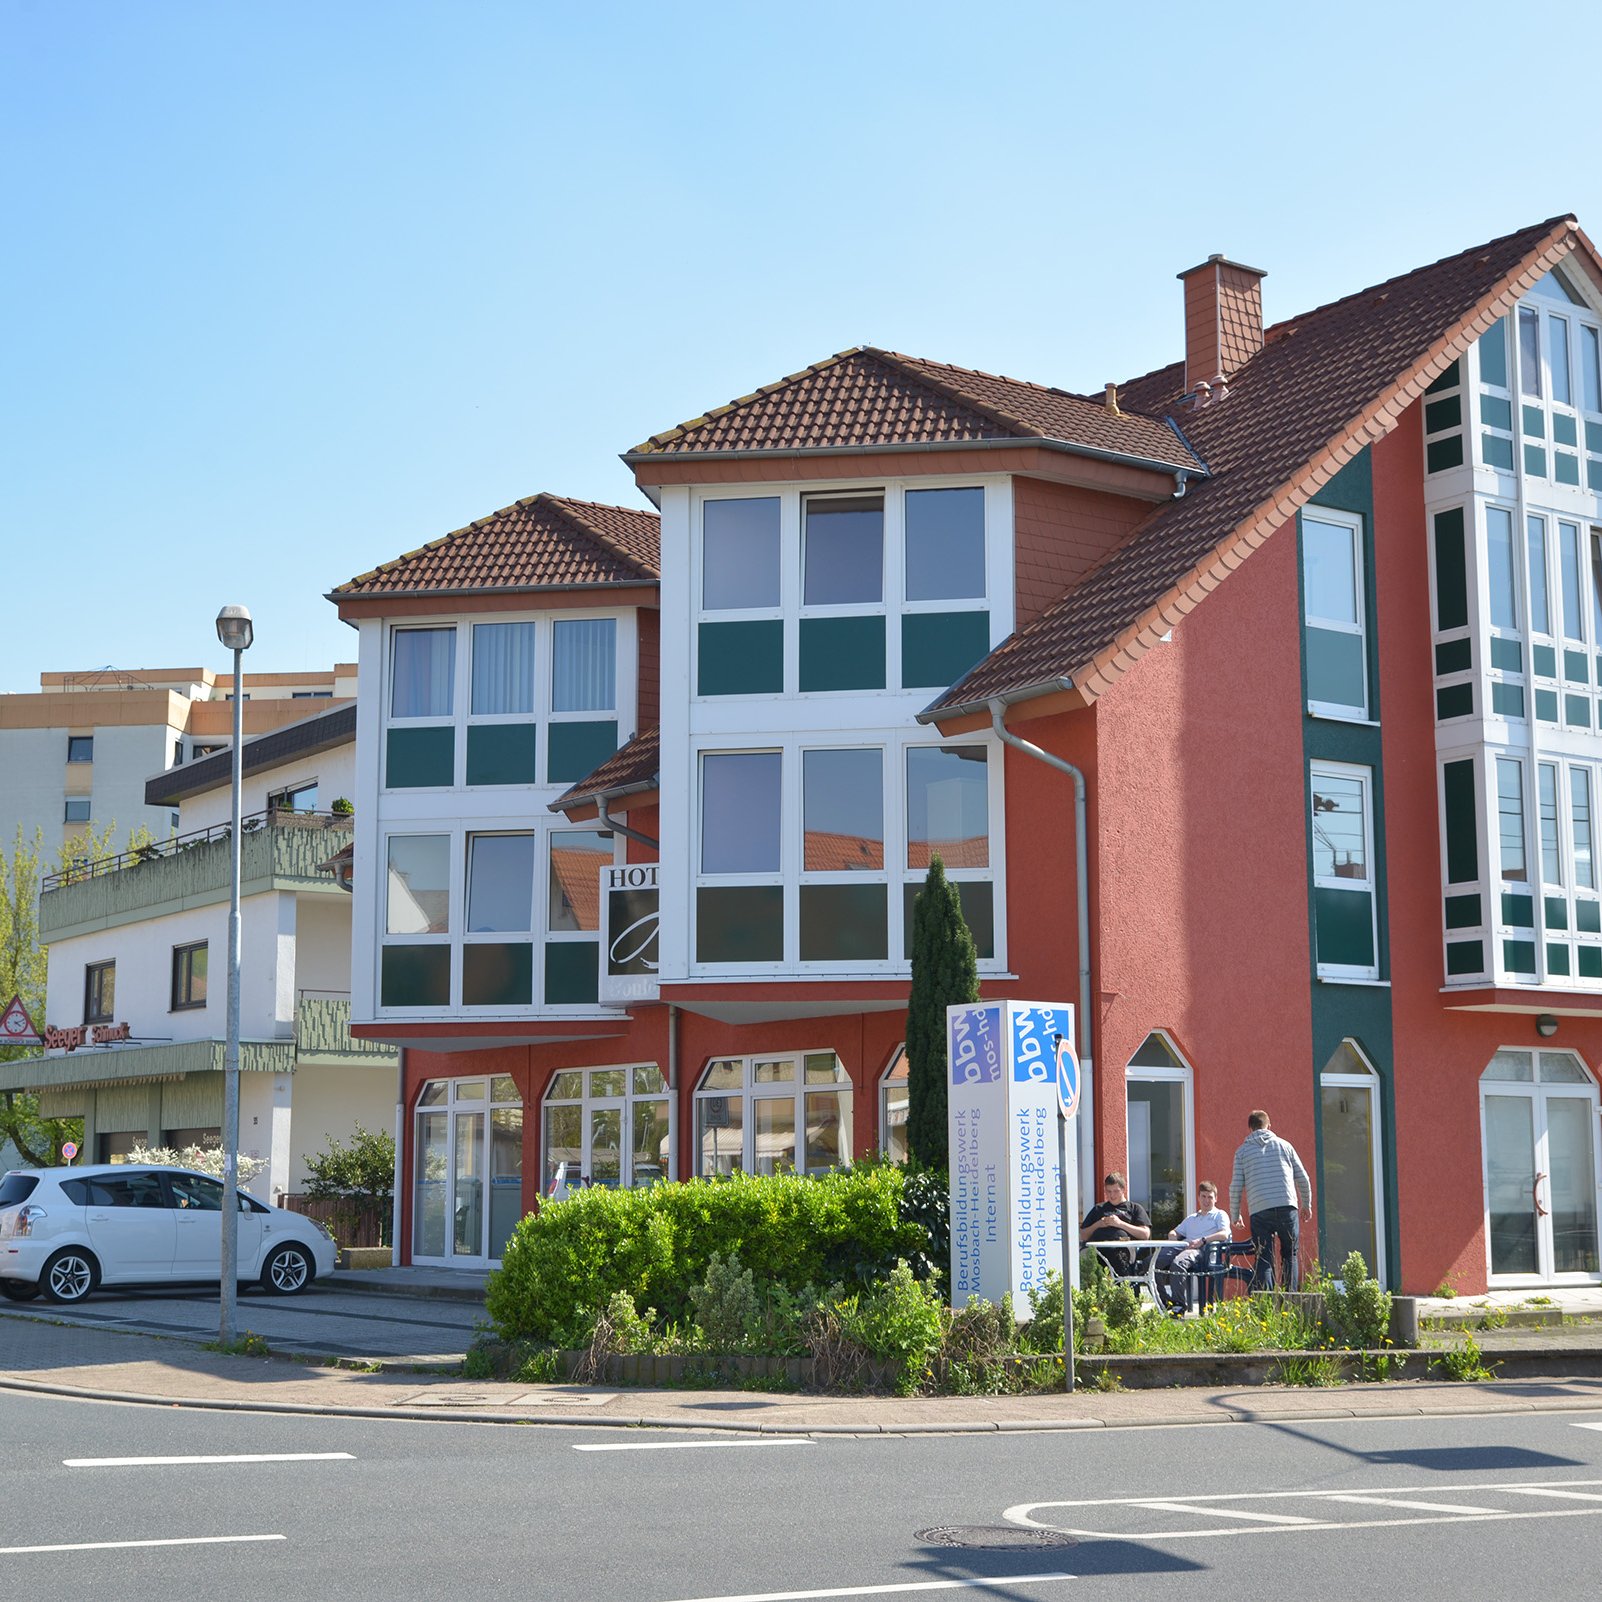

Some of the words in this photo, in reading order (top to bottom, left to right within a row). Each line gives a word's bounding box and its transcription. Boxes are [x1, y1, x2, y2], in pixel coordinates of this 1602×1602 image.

[609, 867, 659, 887] HOT
[45, 1025, 86, 1051] Seeger
[955, 1109, 969, 1291] Berufsbildungswerk
[969, 1108, 981, 1292] Mosbach-Heidelberg
[985, 1164, 997, 1242] Internat
[1016, 1108, 1034, 1292] Berufsbildungswerk
[1034, 1107, 1047, 1292] Mosbach-Heidelberg
[1052, 1164, 1063, 1241] Internat
